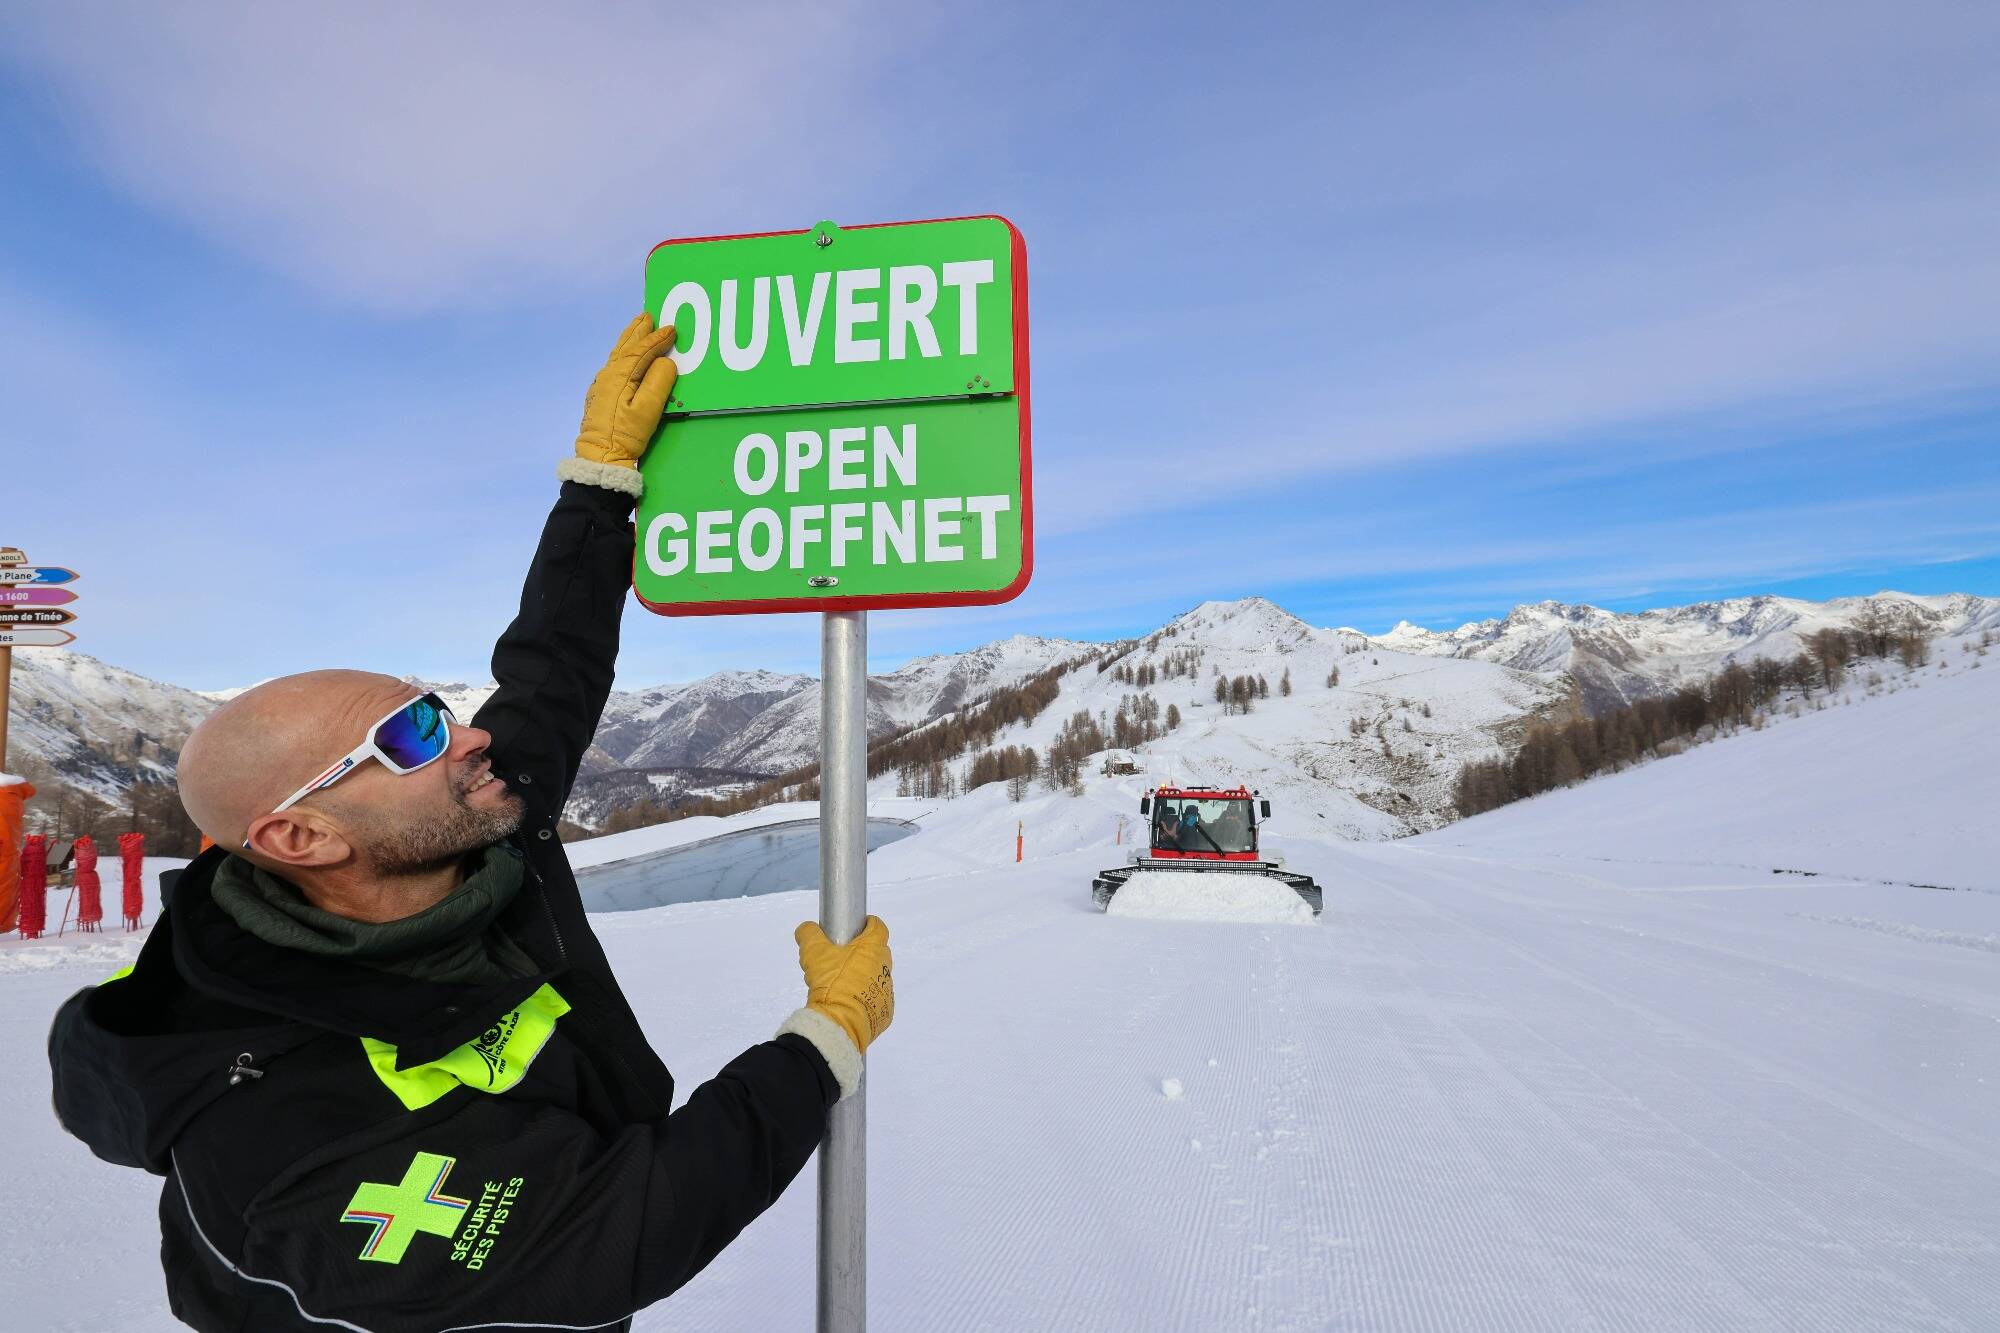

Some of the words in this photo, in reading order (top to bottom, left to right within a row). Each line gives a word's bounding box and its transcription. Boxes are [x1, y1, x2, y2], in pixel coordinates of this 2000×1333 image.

[659, 259, 994, 376] OUVERT
[733, 424, 917, 496] OPEN
[644, 495, 1010, 577] GEOFFNET
[5, 572, 32, 580] Plane
[6, 592, 29, 601] 1600
[21, 612, 33, 621] de
[35, 611, 63, 621] Tinée
[510, 1011, 520, 1029] AZUR
[450, 1180, 503, 1262] SÉCURITÉ
[466, 1238, 495, 1271] DES
[485, 1177, 524, 1235] PISTES
